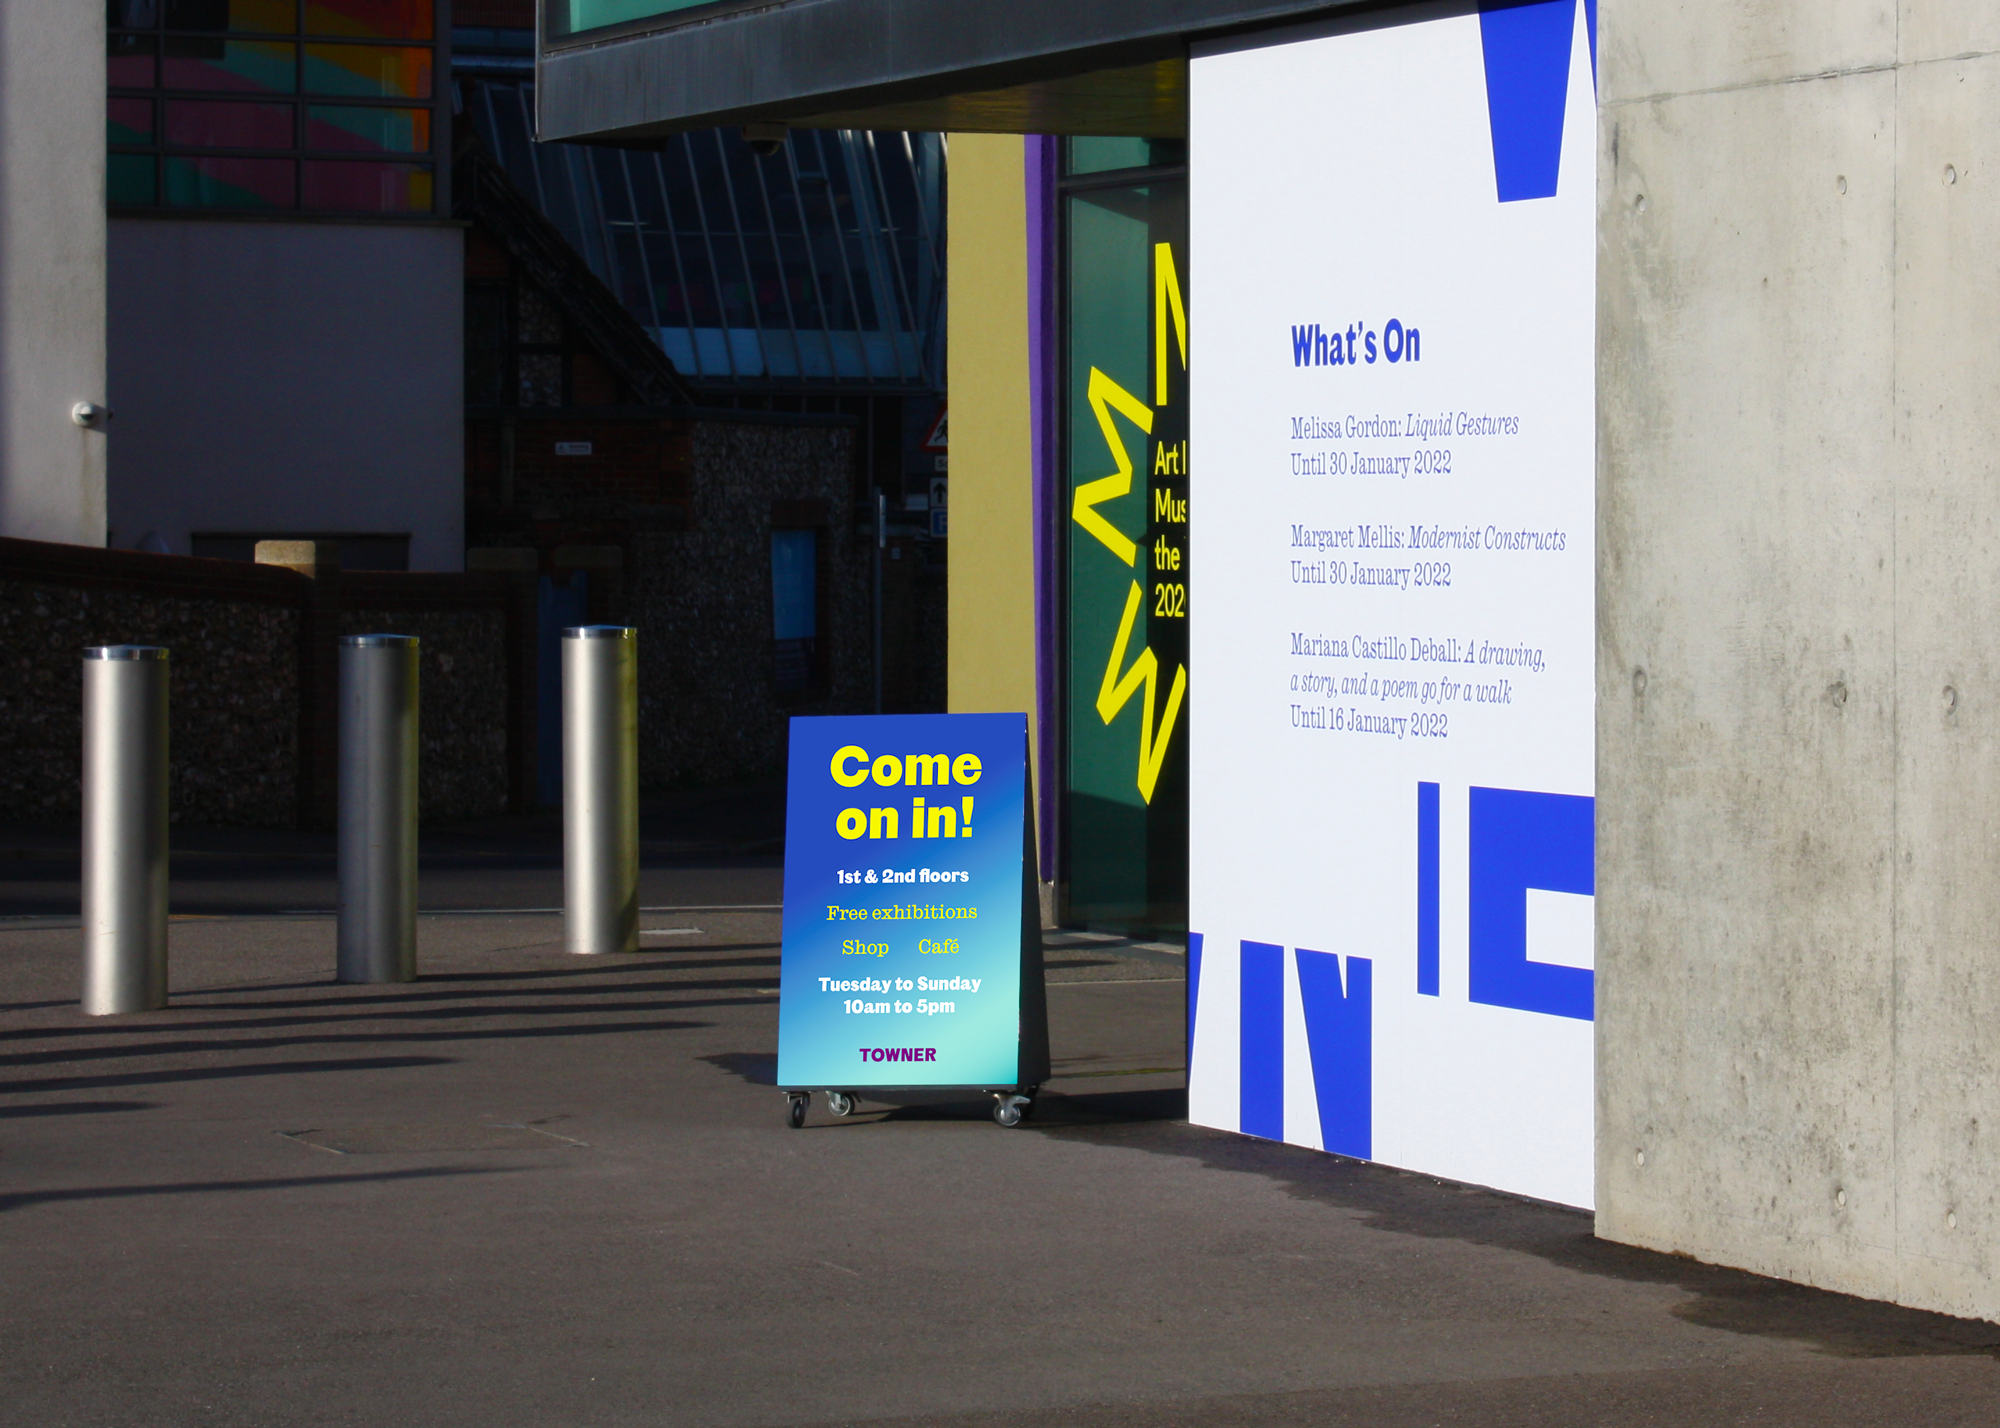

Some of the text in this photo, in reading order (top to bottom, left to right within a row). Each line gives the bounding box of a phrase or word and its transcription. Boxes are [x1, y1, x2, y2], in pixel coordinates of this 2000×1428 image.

[1291, 317, 1421, 368] What’s On
[1291, 411, 1520, 442] Melissa Gordon: Liquid Gestures
[1154, 440, 1179, 476] Art
[1291, 449, 1452, 479] Until 30 January 2022
[1154, 534, 1181, 571] the
[1291, 524, 1566, 553] Margaret Mellis: Modernist Constructs
[1291, 560, 1452, 591] Until 30 January 2022
[1290, 632, 1546, 673] Mariana Castillo Deball: A drawing,
[1290, 671, 1512, 705] a story, and a poem go for a walk
[1290, 704, 1449, 741] Until 16 January 2022
[830, 745, 982, 788] Come
[835, 796, 974, 840] on in!
[836, 868, 970, 884] 1st & 2nd floors
[826, 904, 978, 921] Free exhibitions
[842, 938, 960, 957] Shop Café
[818, 975, 982, 994] Tuesday to Sunday
[843, 998, 956, 1016] 10am to 5pm
[859, 1047, 937, 1063] TOWNER
